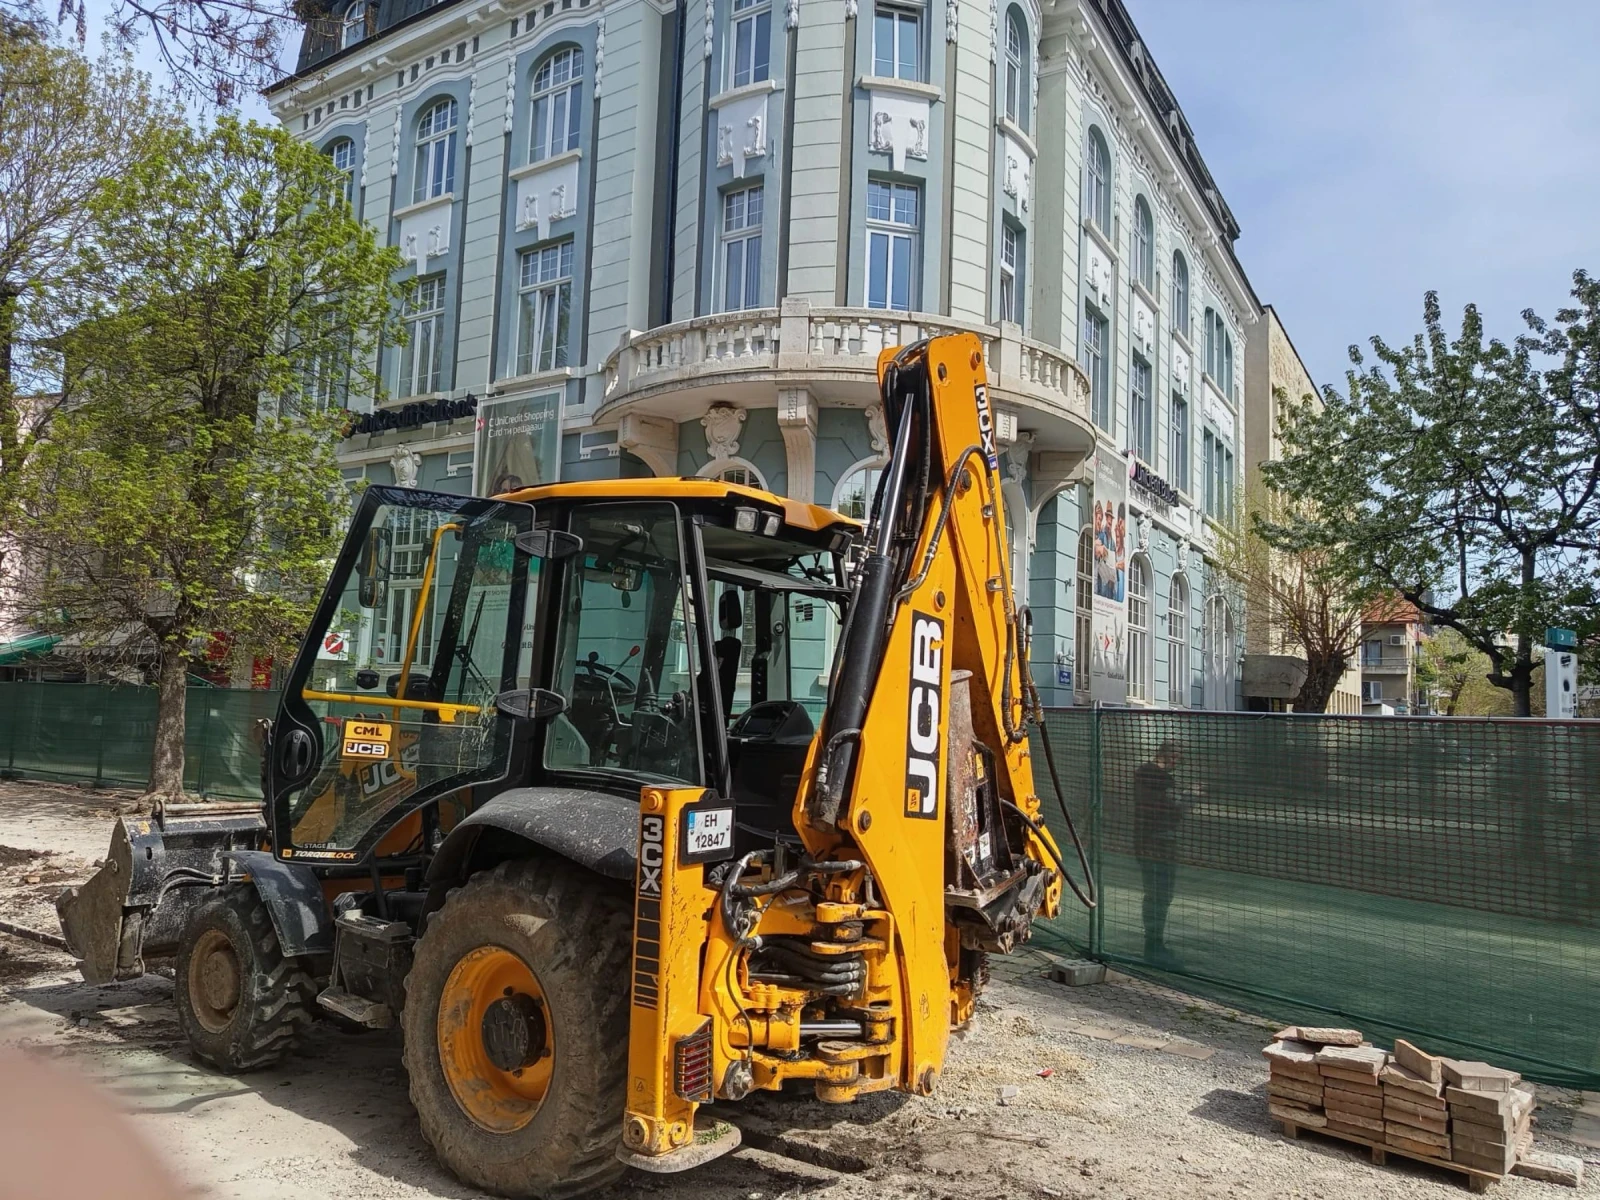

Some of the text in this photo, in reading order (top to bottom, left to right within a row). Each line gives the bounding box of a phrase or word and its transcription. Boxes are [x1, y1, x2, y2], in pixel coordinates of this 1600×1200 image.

[494, 413, 523, 426] UniCredit
[523, 408, 555, 422] Shopping
[975, 386, 995, 455] 3CX
[909, 618, 943, 814] JCB
[353, 726, 383, 737] CML
[346, 742, 386, 755] JCB
[704, 814, 718, 828] EH
[695, 832, 725, 849] 12847
[640, 817, 663, 893] 3CX
